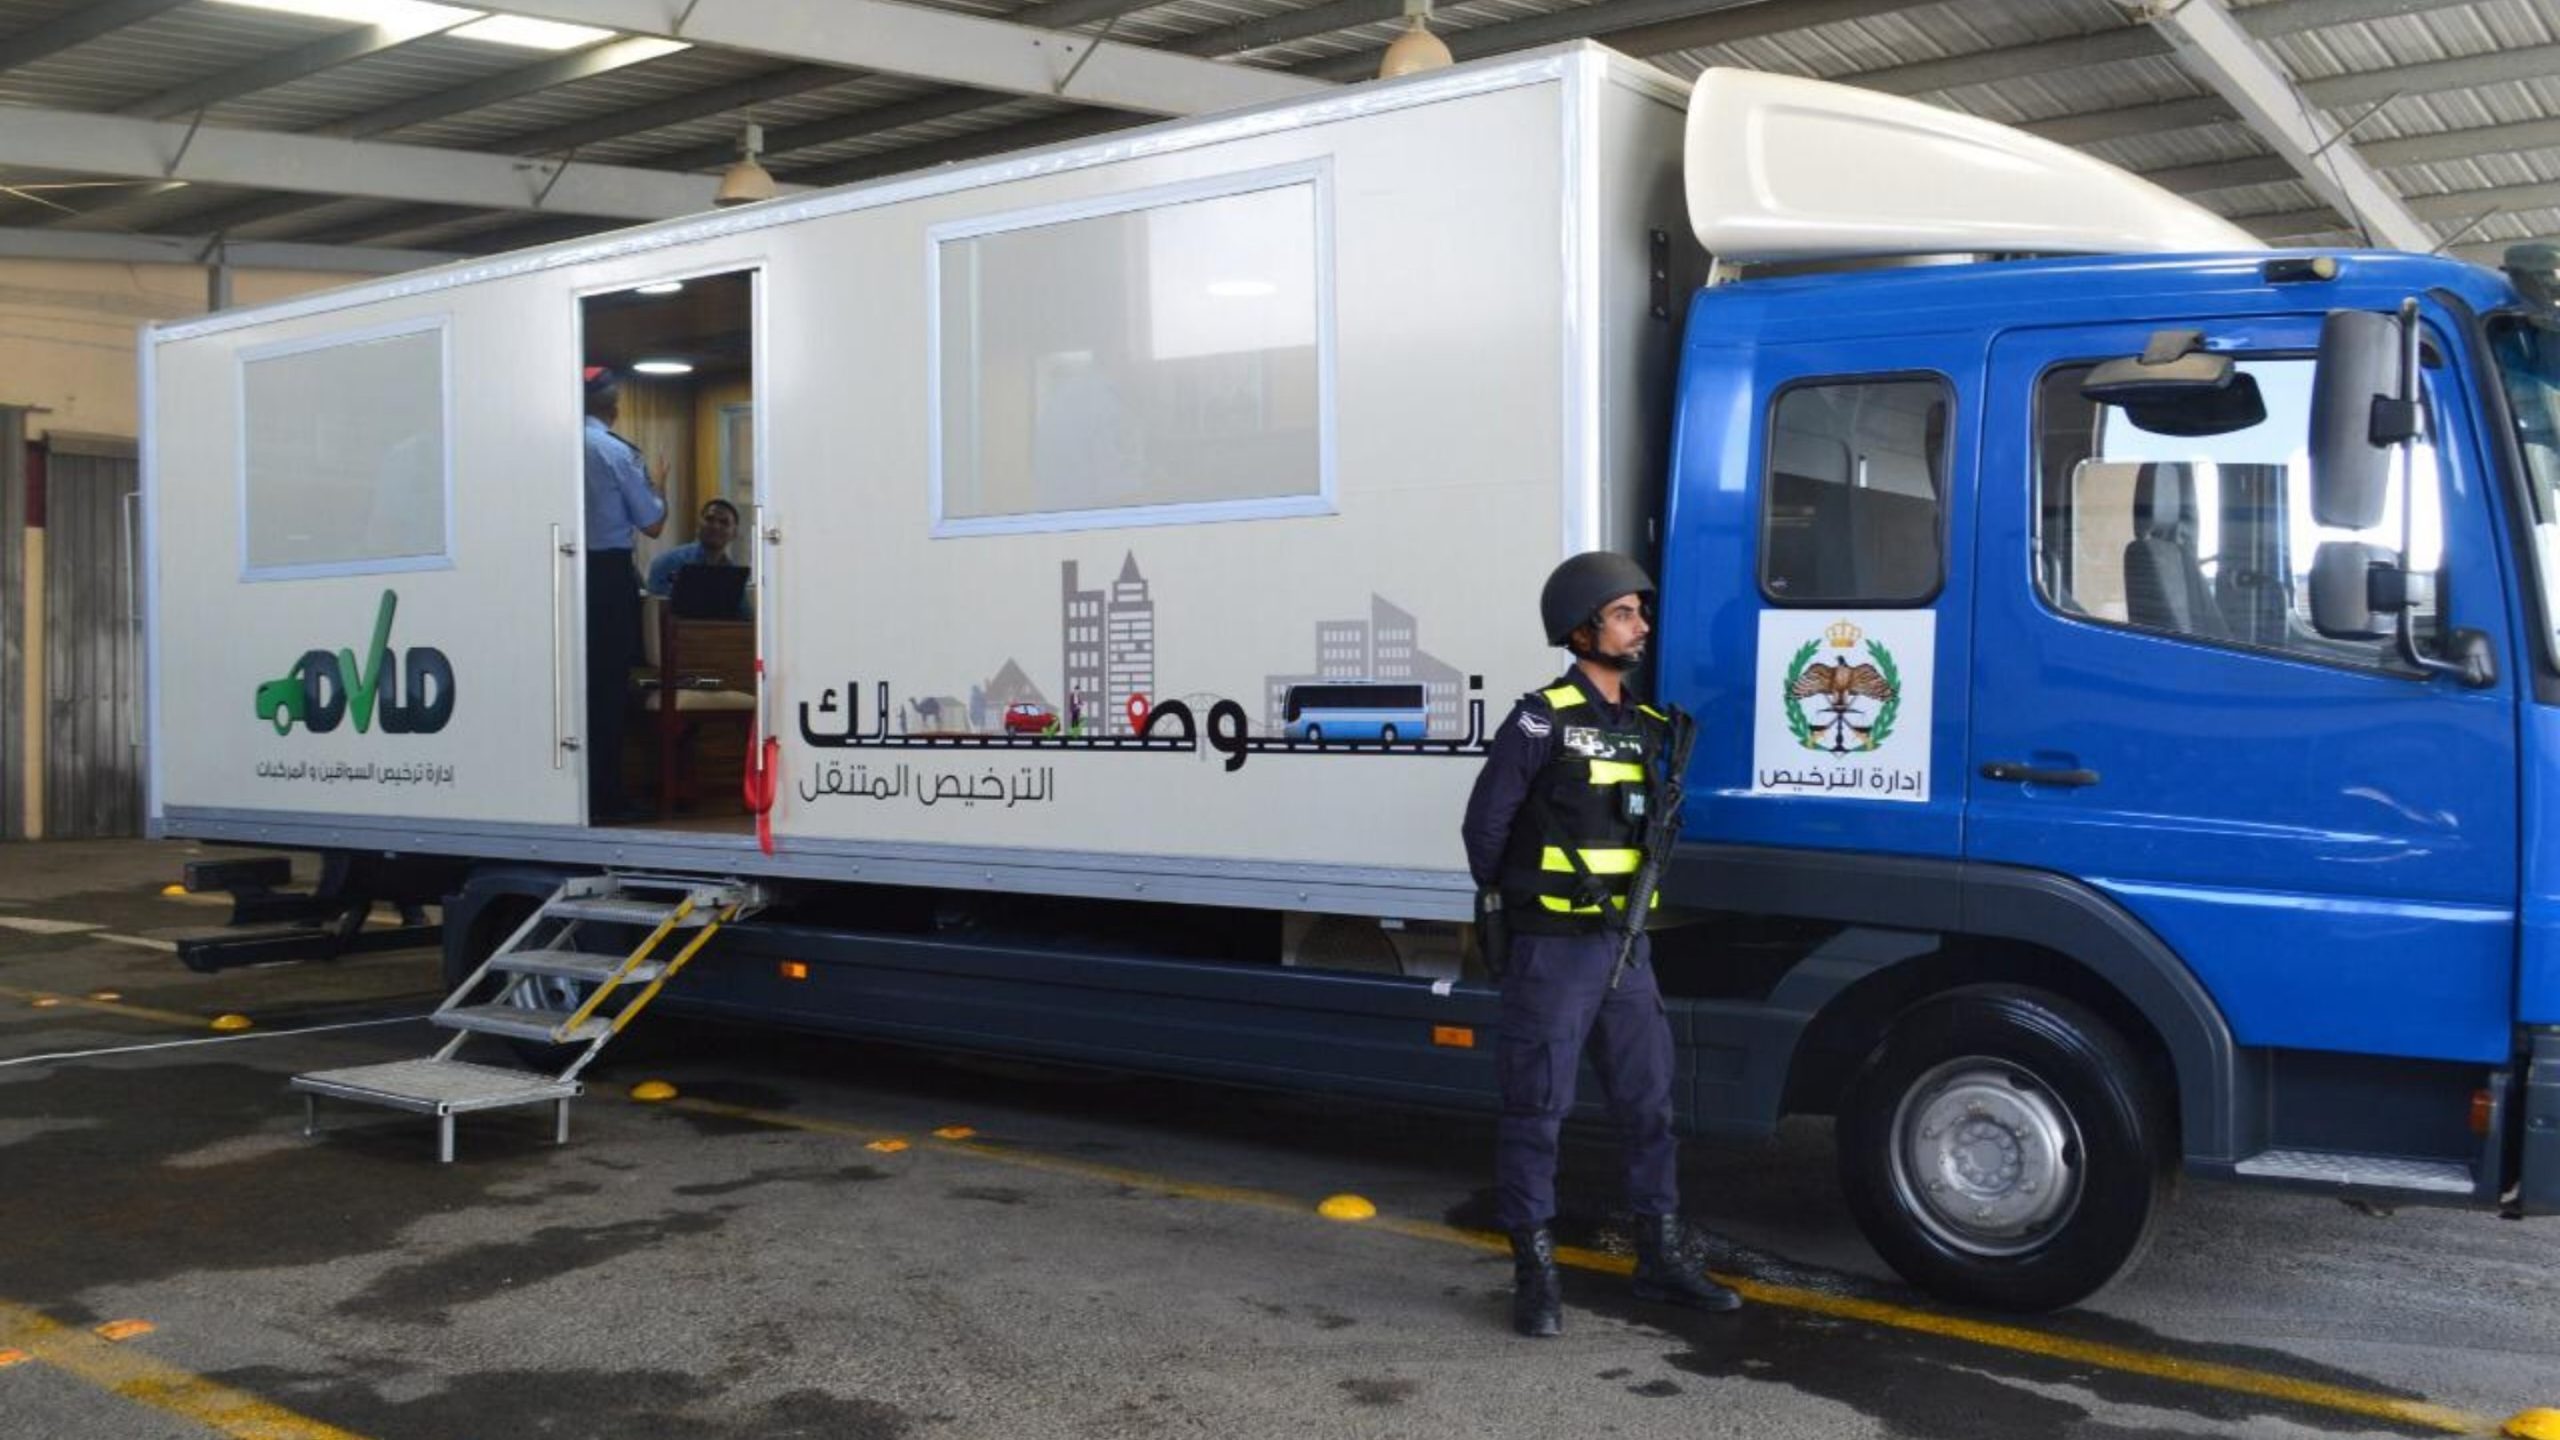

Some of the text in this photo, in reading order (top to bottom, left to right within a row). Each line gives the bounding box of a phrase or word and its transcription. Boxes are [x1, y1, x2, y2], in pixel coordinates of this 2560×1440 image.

[256, 760, 455, 789] إدارة ترخيص السواقين و المركبات
[799, 760, 1053, 808] الترخيص المتنقل
[1759, 766, 1922, 798] إدارة الترخيص
